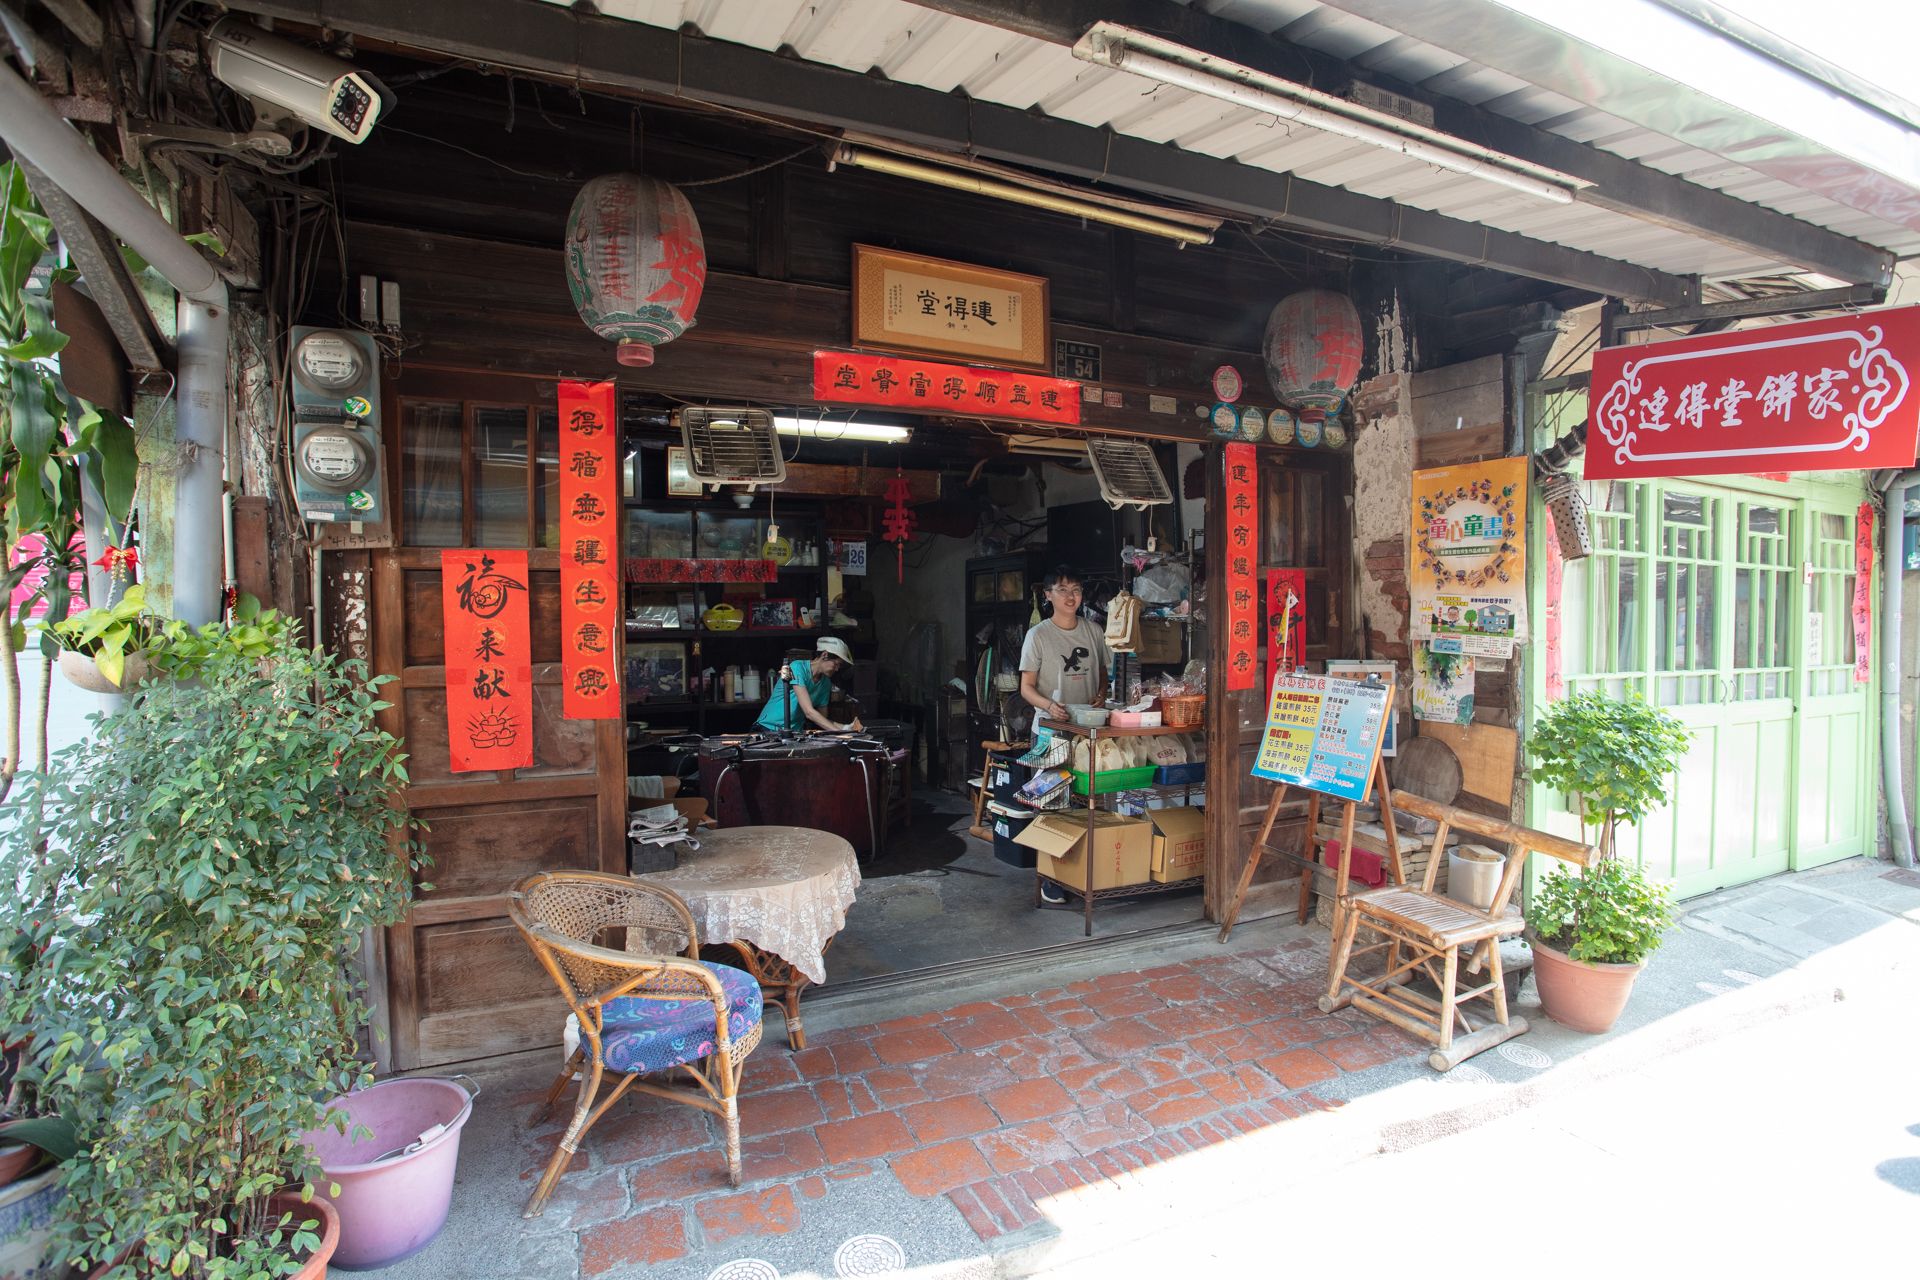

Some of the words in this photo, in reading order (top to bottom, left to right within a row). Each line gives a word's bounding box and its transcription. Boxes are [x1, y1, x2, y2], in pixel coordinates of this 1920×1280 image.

[1074, 358, 1094, 379] 54
[1637, 367, 1850, 433] 連得堂餅家
[1429, 514, 1504, 543] 童心童畫
[569, 409, 610, 699] 得福無疆生意興
[850, 549, 865, 565] 26
[1302, 704, 1318, 714] 35元
[1300, 715, 1316, 725] 40元
[1294, 742, 1310, 753] 35元
[1291, 753, 1307, 764] 40元
